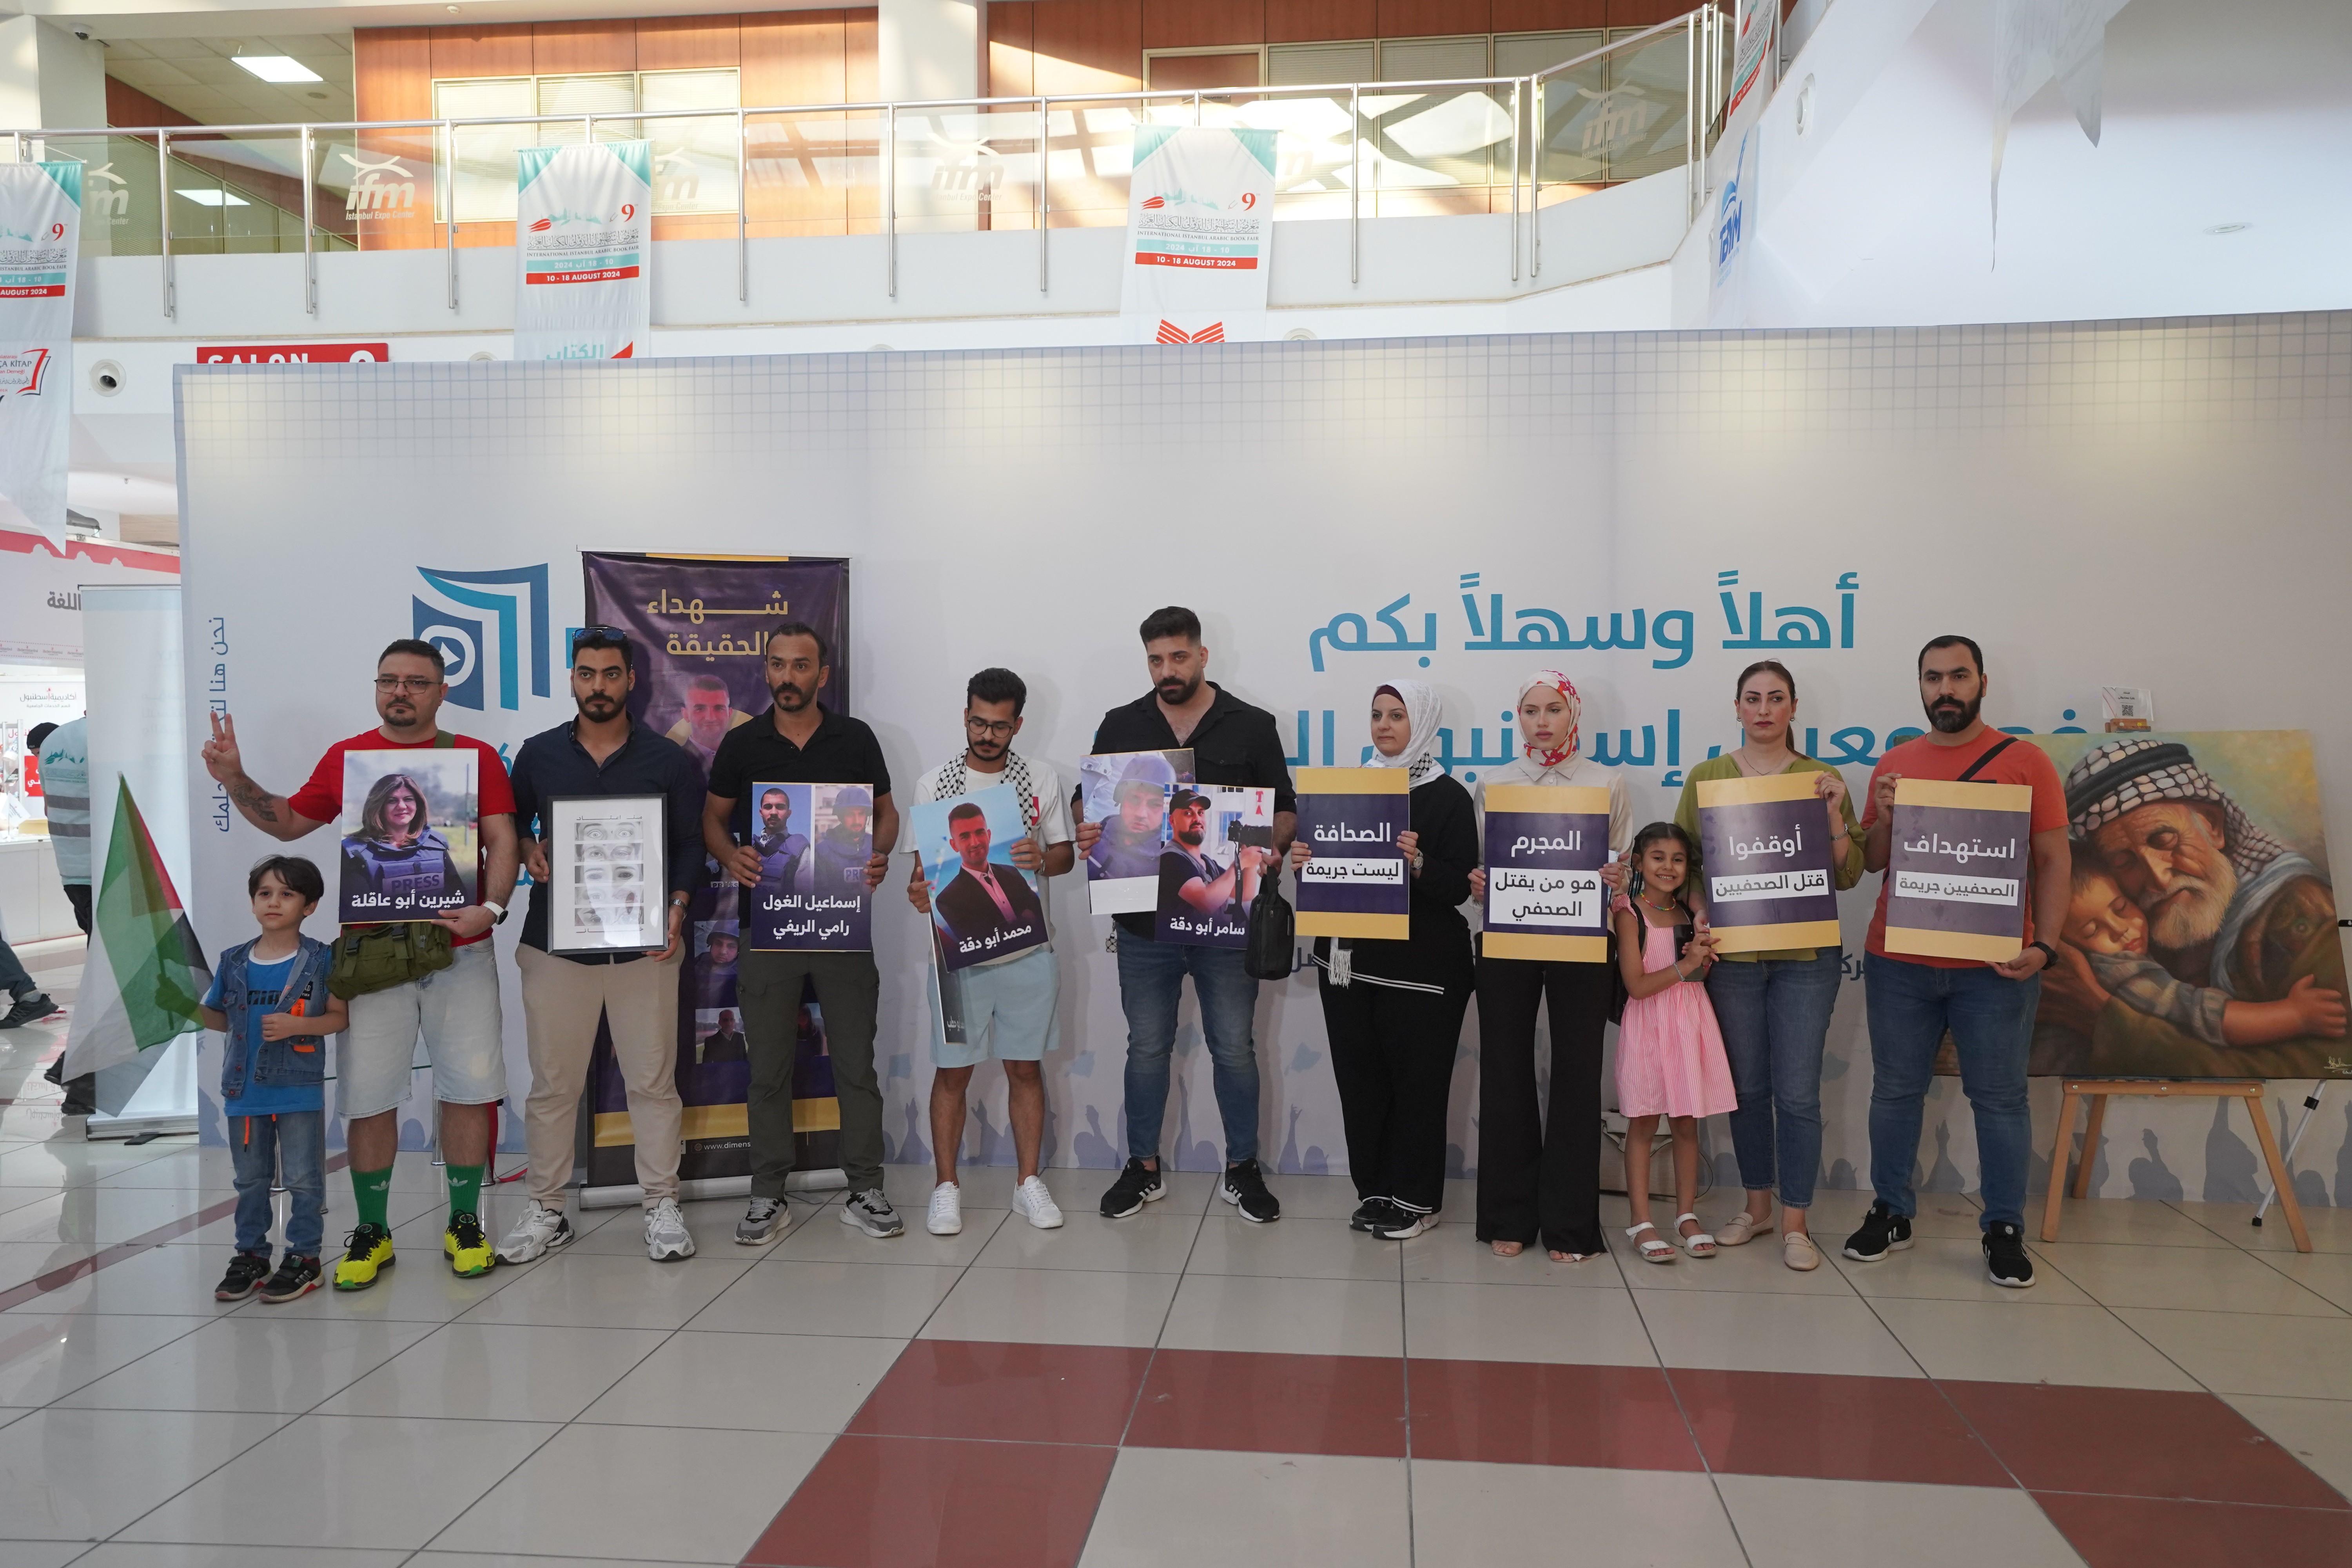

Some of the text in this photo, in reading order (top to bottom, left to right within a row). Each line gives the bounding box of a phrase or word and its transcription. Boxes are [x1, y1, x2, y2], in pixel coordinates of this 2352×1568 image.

[931, 158, 1004, 190] ifm
[346, 173, 416, 210] ifm
[978, 192, 1002, 201] Center
[375, 211, 390, 220] Expo
[392, 210, 415, 218] Center
[572, 272, 601, 281] AUGUST
[47, 591, 82, 611] اللغة
[647, 589, 788, 625] شهداء
[208, 617, 229, 656] نحن
[1308, 593, 1437, 672] بكم
[666, 631, 769, 662] الحقيقة
[209, 663, 226, 692] هنا
[1314, 822, 1390, 842] الصحافة
[1729, 823, 1802, 861] أوقفوا
[1511, 830, 1581, 858] المجرم
[1904, 833, 2015, 864] استهداف
[1306, 862, 1399, 880] ليست جريمة
[391, 875, 439, 893] PRESS
[1495, 872, 1596, 894] هو من يقتل
[1716, 873, 1825, 897] قتل الصحفيين
[1900, 877, 2014, 897] الصحفيين جريمة
[351, 889, 465, 909] شيرين أبو عاقلة
[763, 894, 861, 913] إسماعيل الغول
[1512, 901, 1582, 922] الصحفي
[773, 919, 850, 940] رامي الريفي
[1170, 916, 1245, 936] سامر أبو دقة
[959, 925, 1032, 953] محمد أبو دقة
